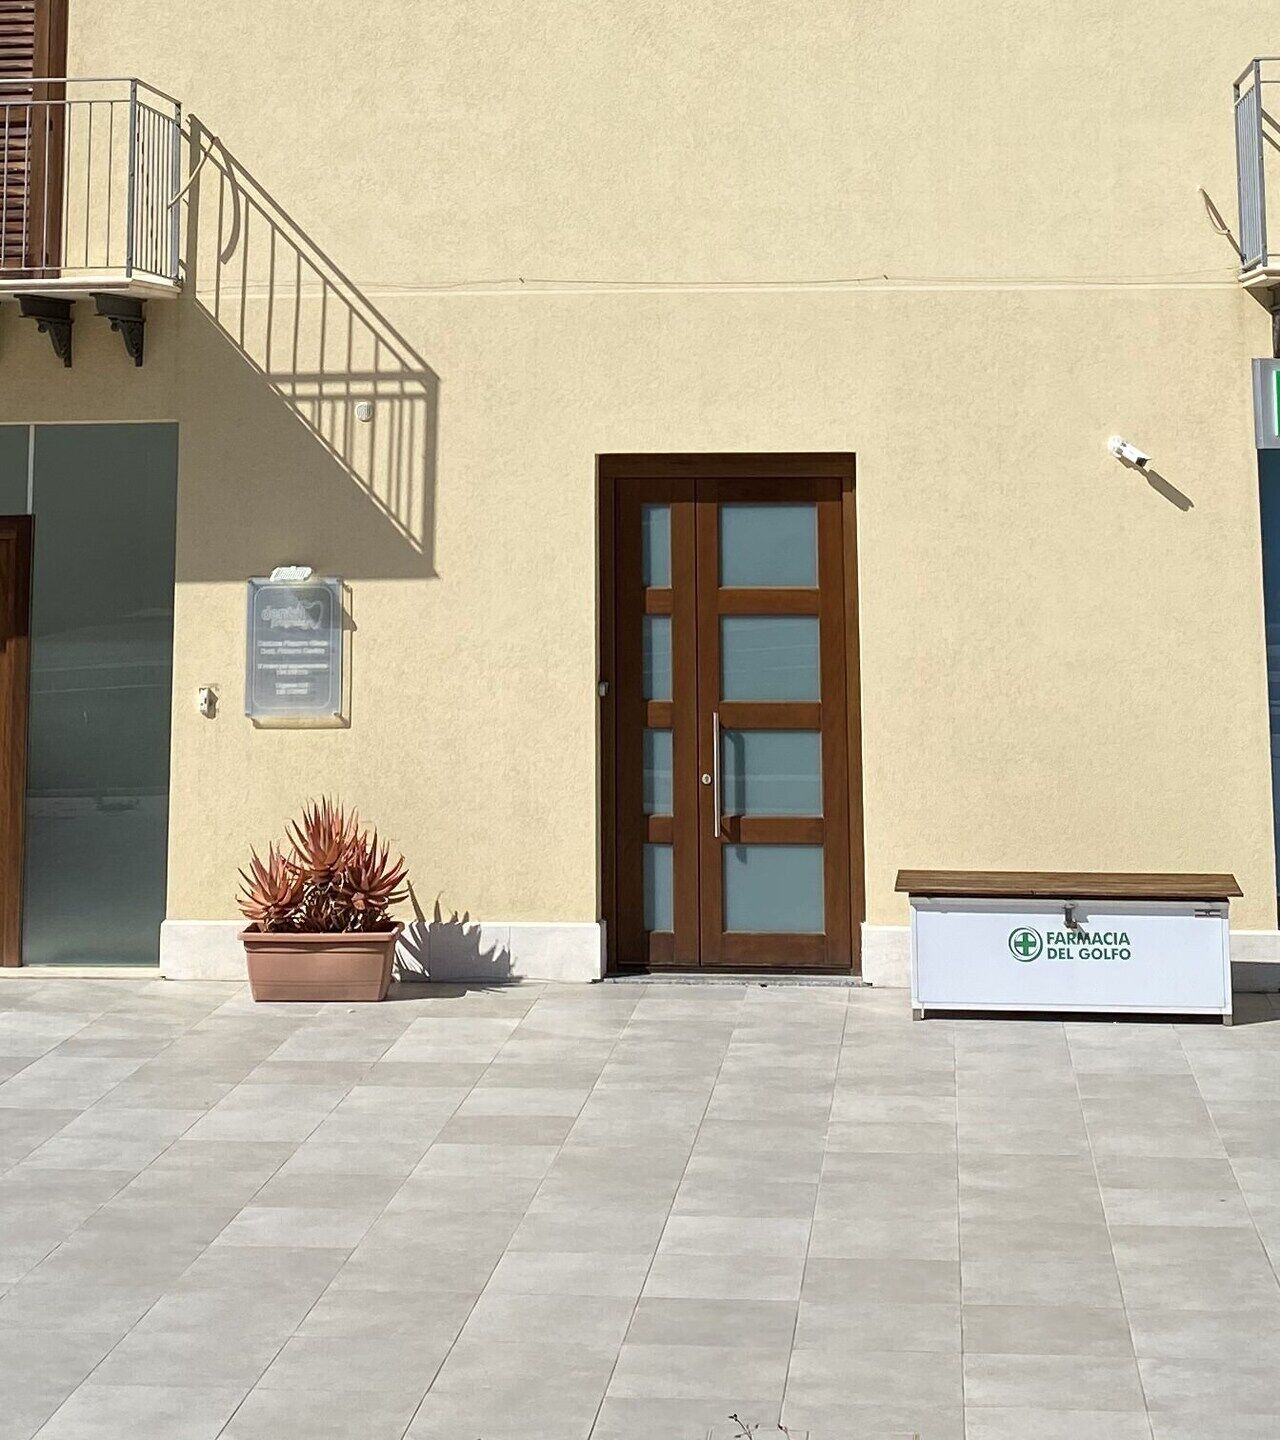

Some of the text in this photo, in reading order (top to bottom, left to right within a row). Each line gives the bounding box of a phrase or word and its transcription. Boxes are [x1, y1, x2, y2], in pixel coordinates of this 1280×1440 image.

[1046, 931, 1131, 945] FARMACIA
[1047, 947, 1132, 960] DEL GOLFO
